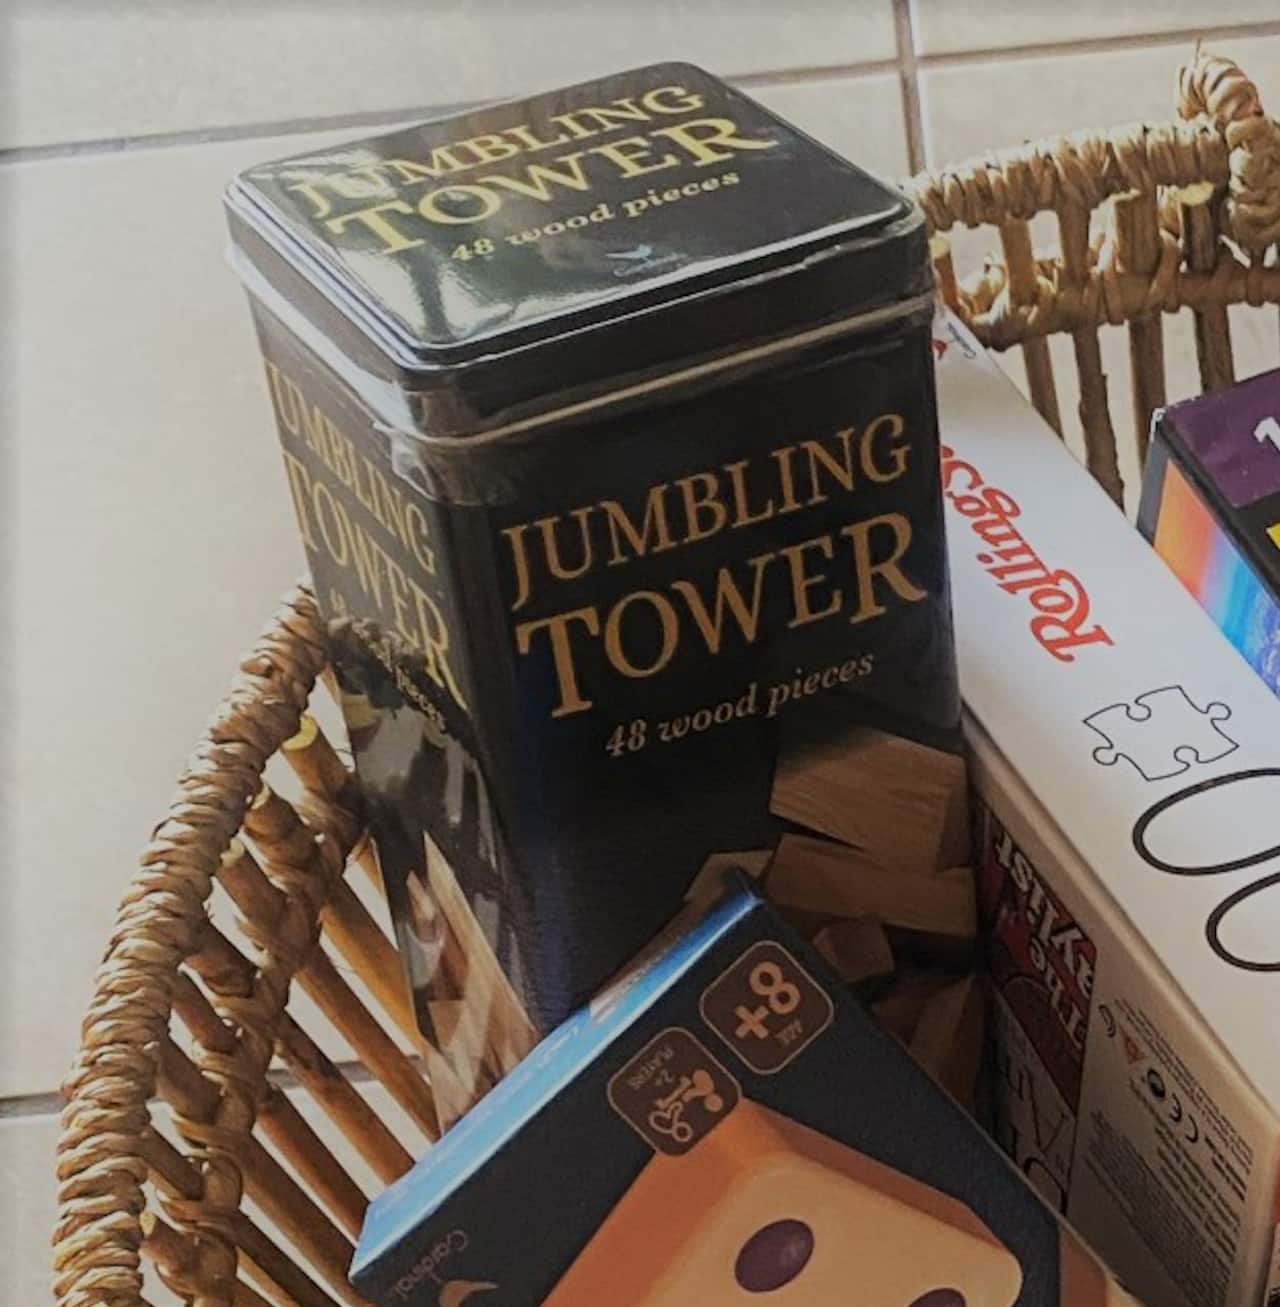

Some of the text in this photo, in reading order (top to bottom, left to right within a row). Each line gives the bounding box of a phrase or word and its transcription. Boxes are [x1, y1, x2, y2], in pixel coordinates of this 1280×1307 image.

[288, 84, 706, 218] JUMBLING
[324, 117, 780, 255] TOWER
[451, 171, 741, 261] 48 wood pieces
[265, 360, 435, 574] UMBLING
[501, 413, 910, 610] JUMBLING
[515, 512, 930, 720] TOWER
[605, 650, 875, 757] 48 wood pieces
[734, 961, 800, 1039] 8+
